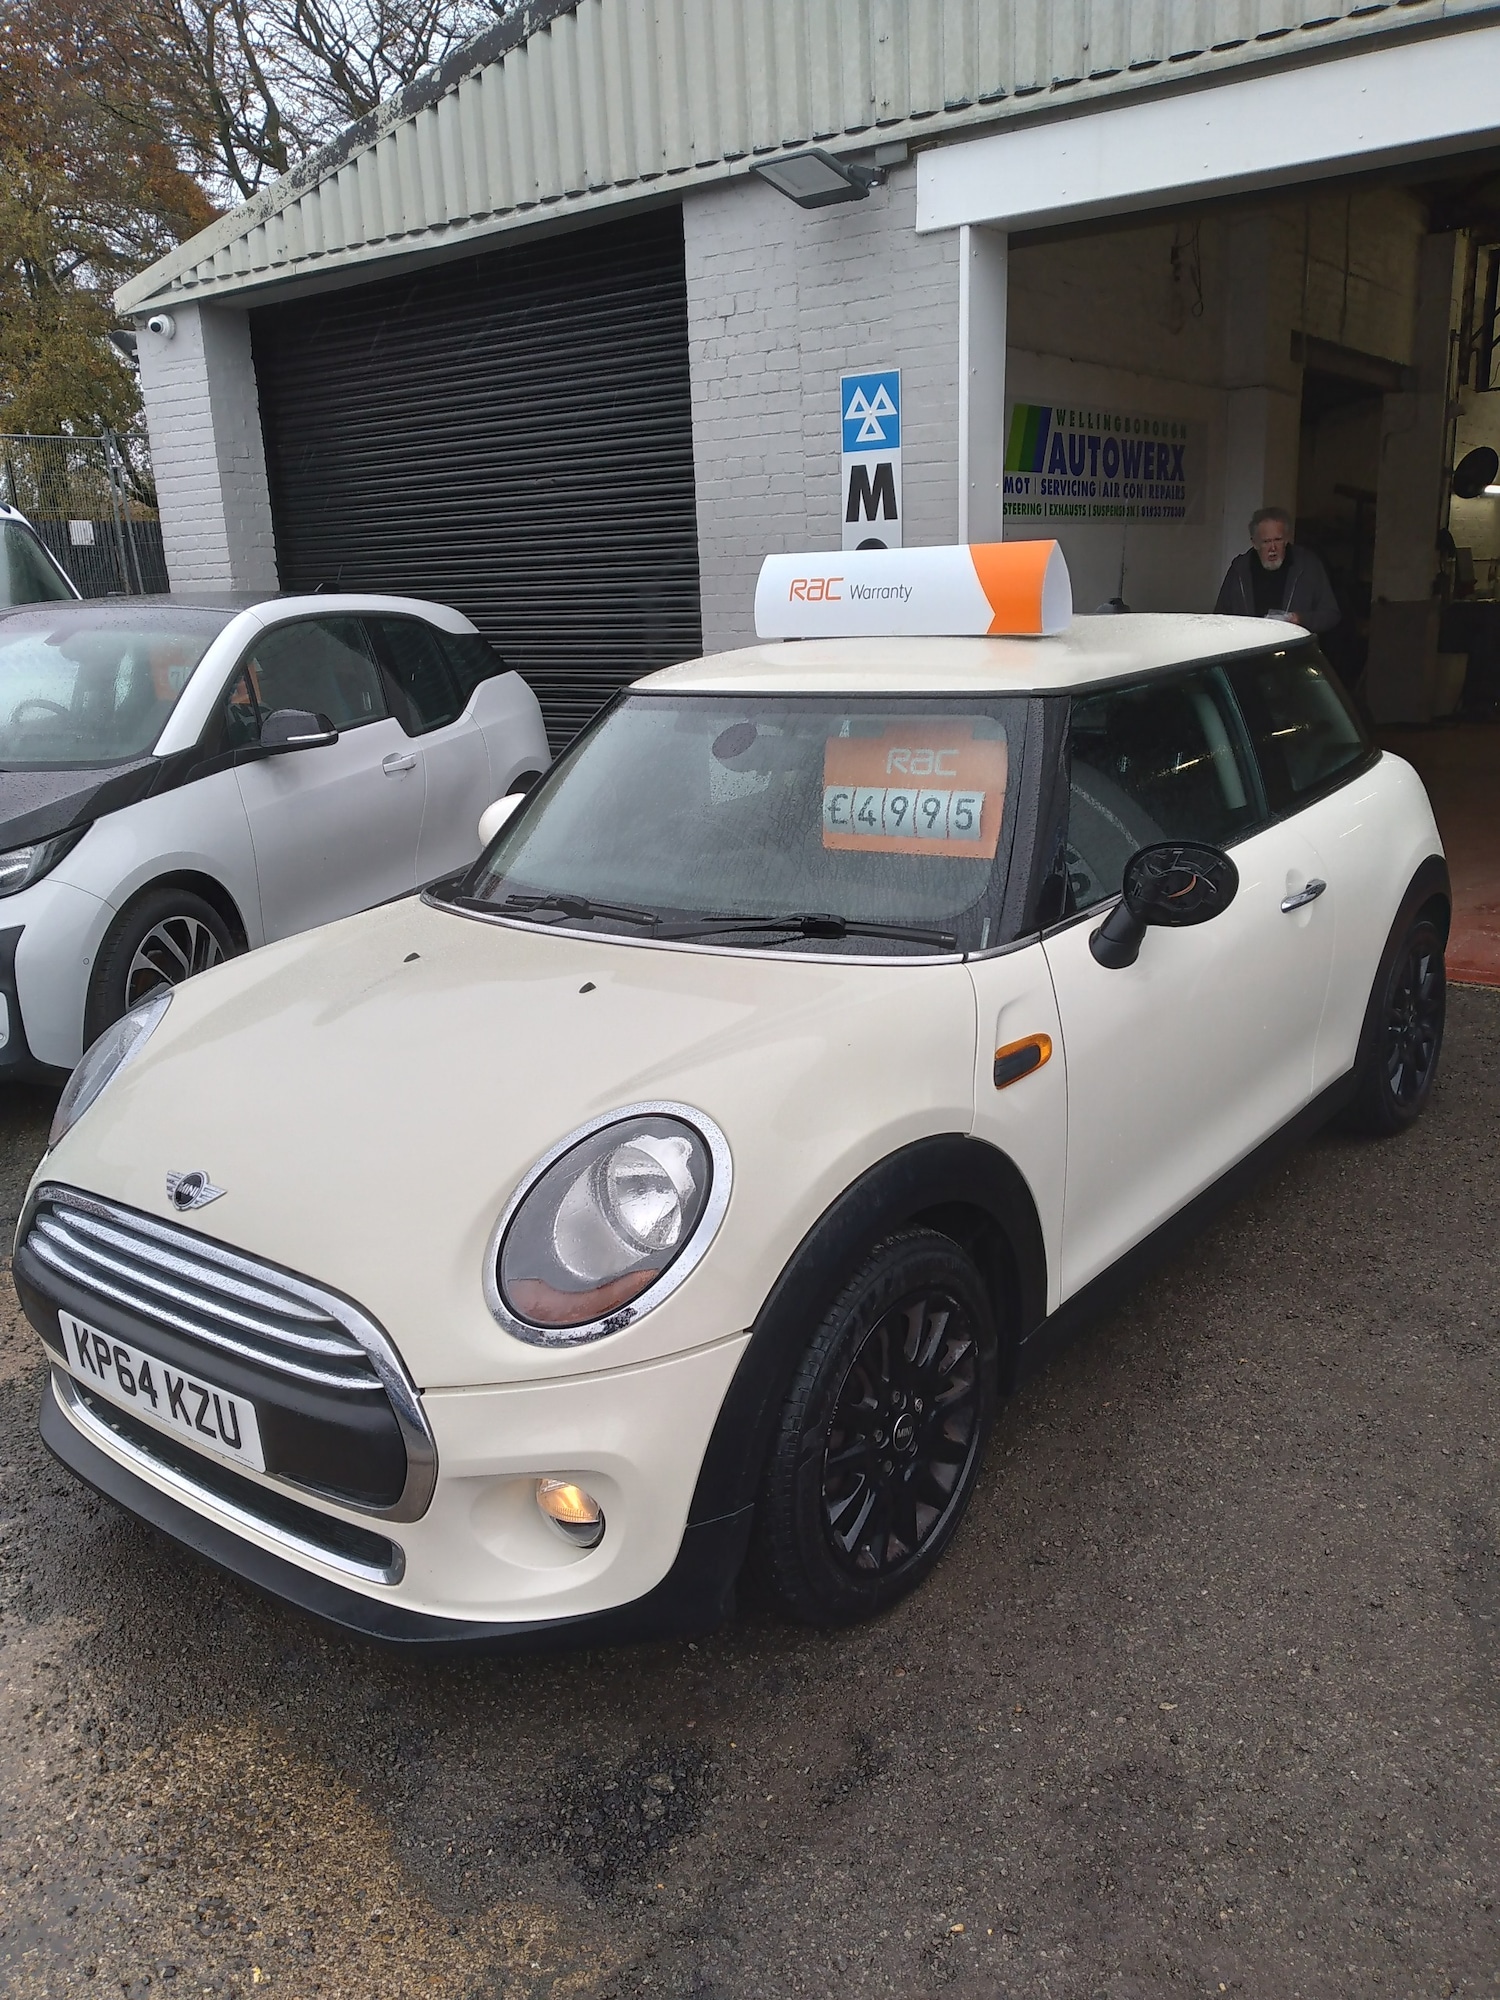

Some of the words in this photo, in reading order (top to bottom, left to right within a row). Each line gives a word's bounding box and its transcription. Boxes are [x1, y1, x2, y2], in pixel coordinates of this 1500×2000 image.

[1057, 408, 1187, 440] WELLINGBOROUGH
[1048, 431, 1186, 482] AUTOWERX
[1003, 476, 1030, 495] MOT
[1041, 478, 1096, 497] SERVICING
[1102, 481, 1120, 499] AIR
[1123, 483, 1143, 499] CON
[1149, 484, 1186, 500] REPAIRS
[1003, 502, 1042, 516] STEERING
[1050, 503, 1086, 517] EXHAUSTS
[850, 583, 913, 603] Warranty
[71, 1321, 158, 1410] KP64
[164, 1369, 242, 1450] KZU
